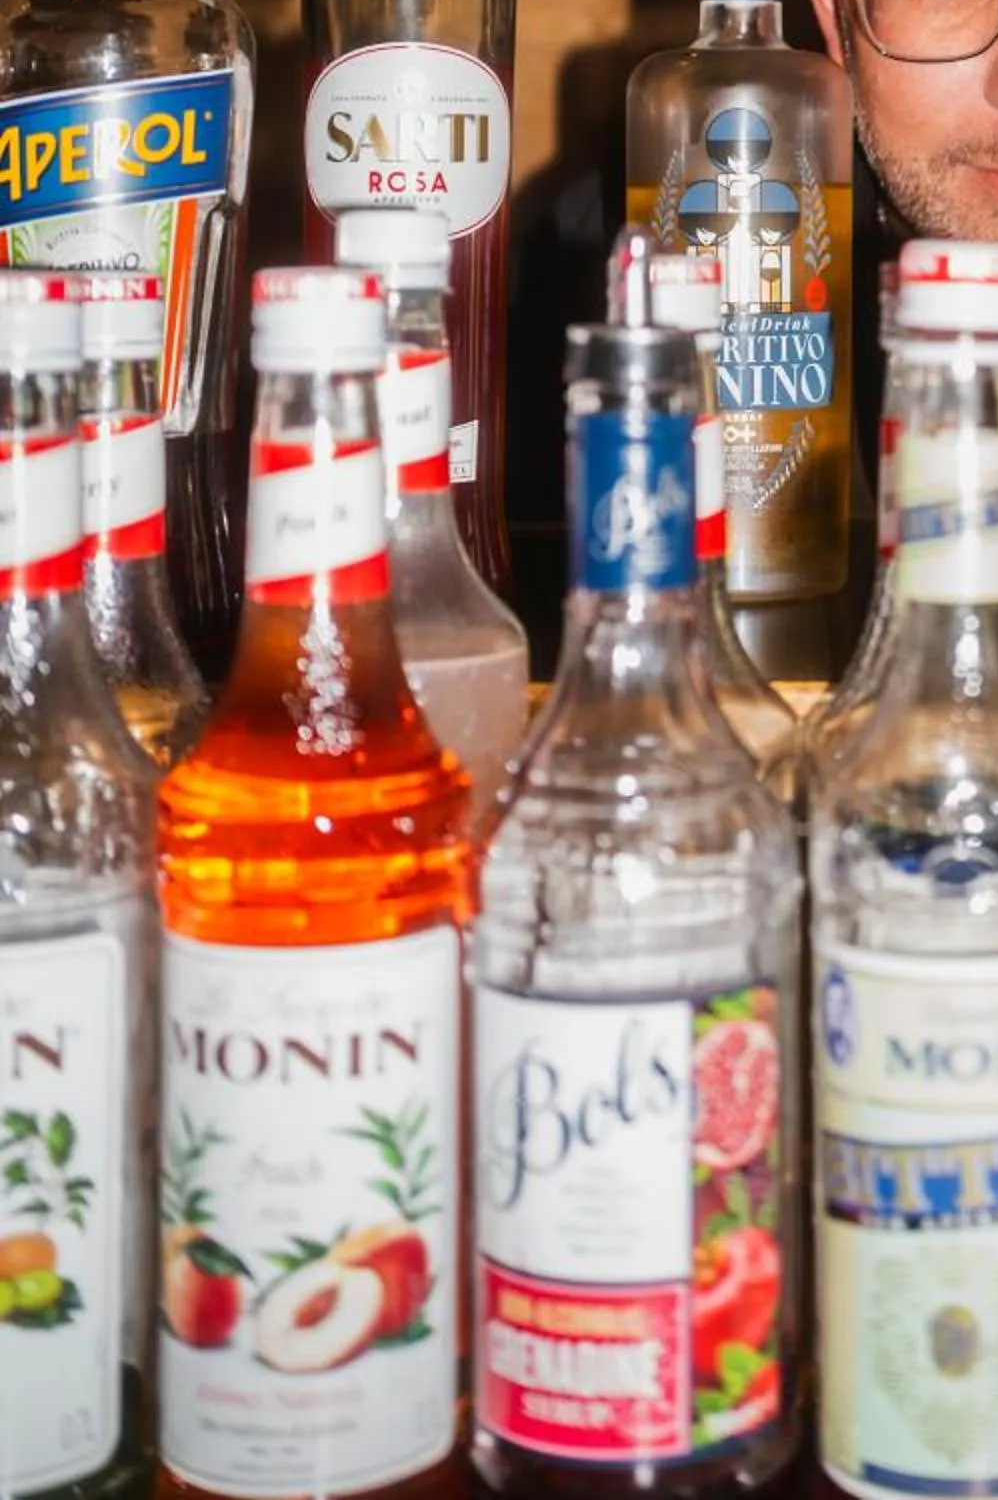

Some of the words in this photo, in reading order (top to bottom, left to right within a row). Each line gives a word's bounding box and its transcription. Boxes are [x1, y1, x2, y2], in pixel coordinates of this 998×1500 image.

[0, 108, 207, 200] APEROL
[326, 111, 490, 163] SARTI
[369, 171, 448, 193] ROSA
[716, 333, 825, 363] RITIVO
[168, 1020, 420, 1085] MONIN
[486, 1014, 676, 1213] Bols
